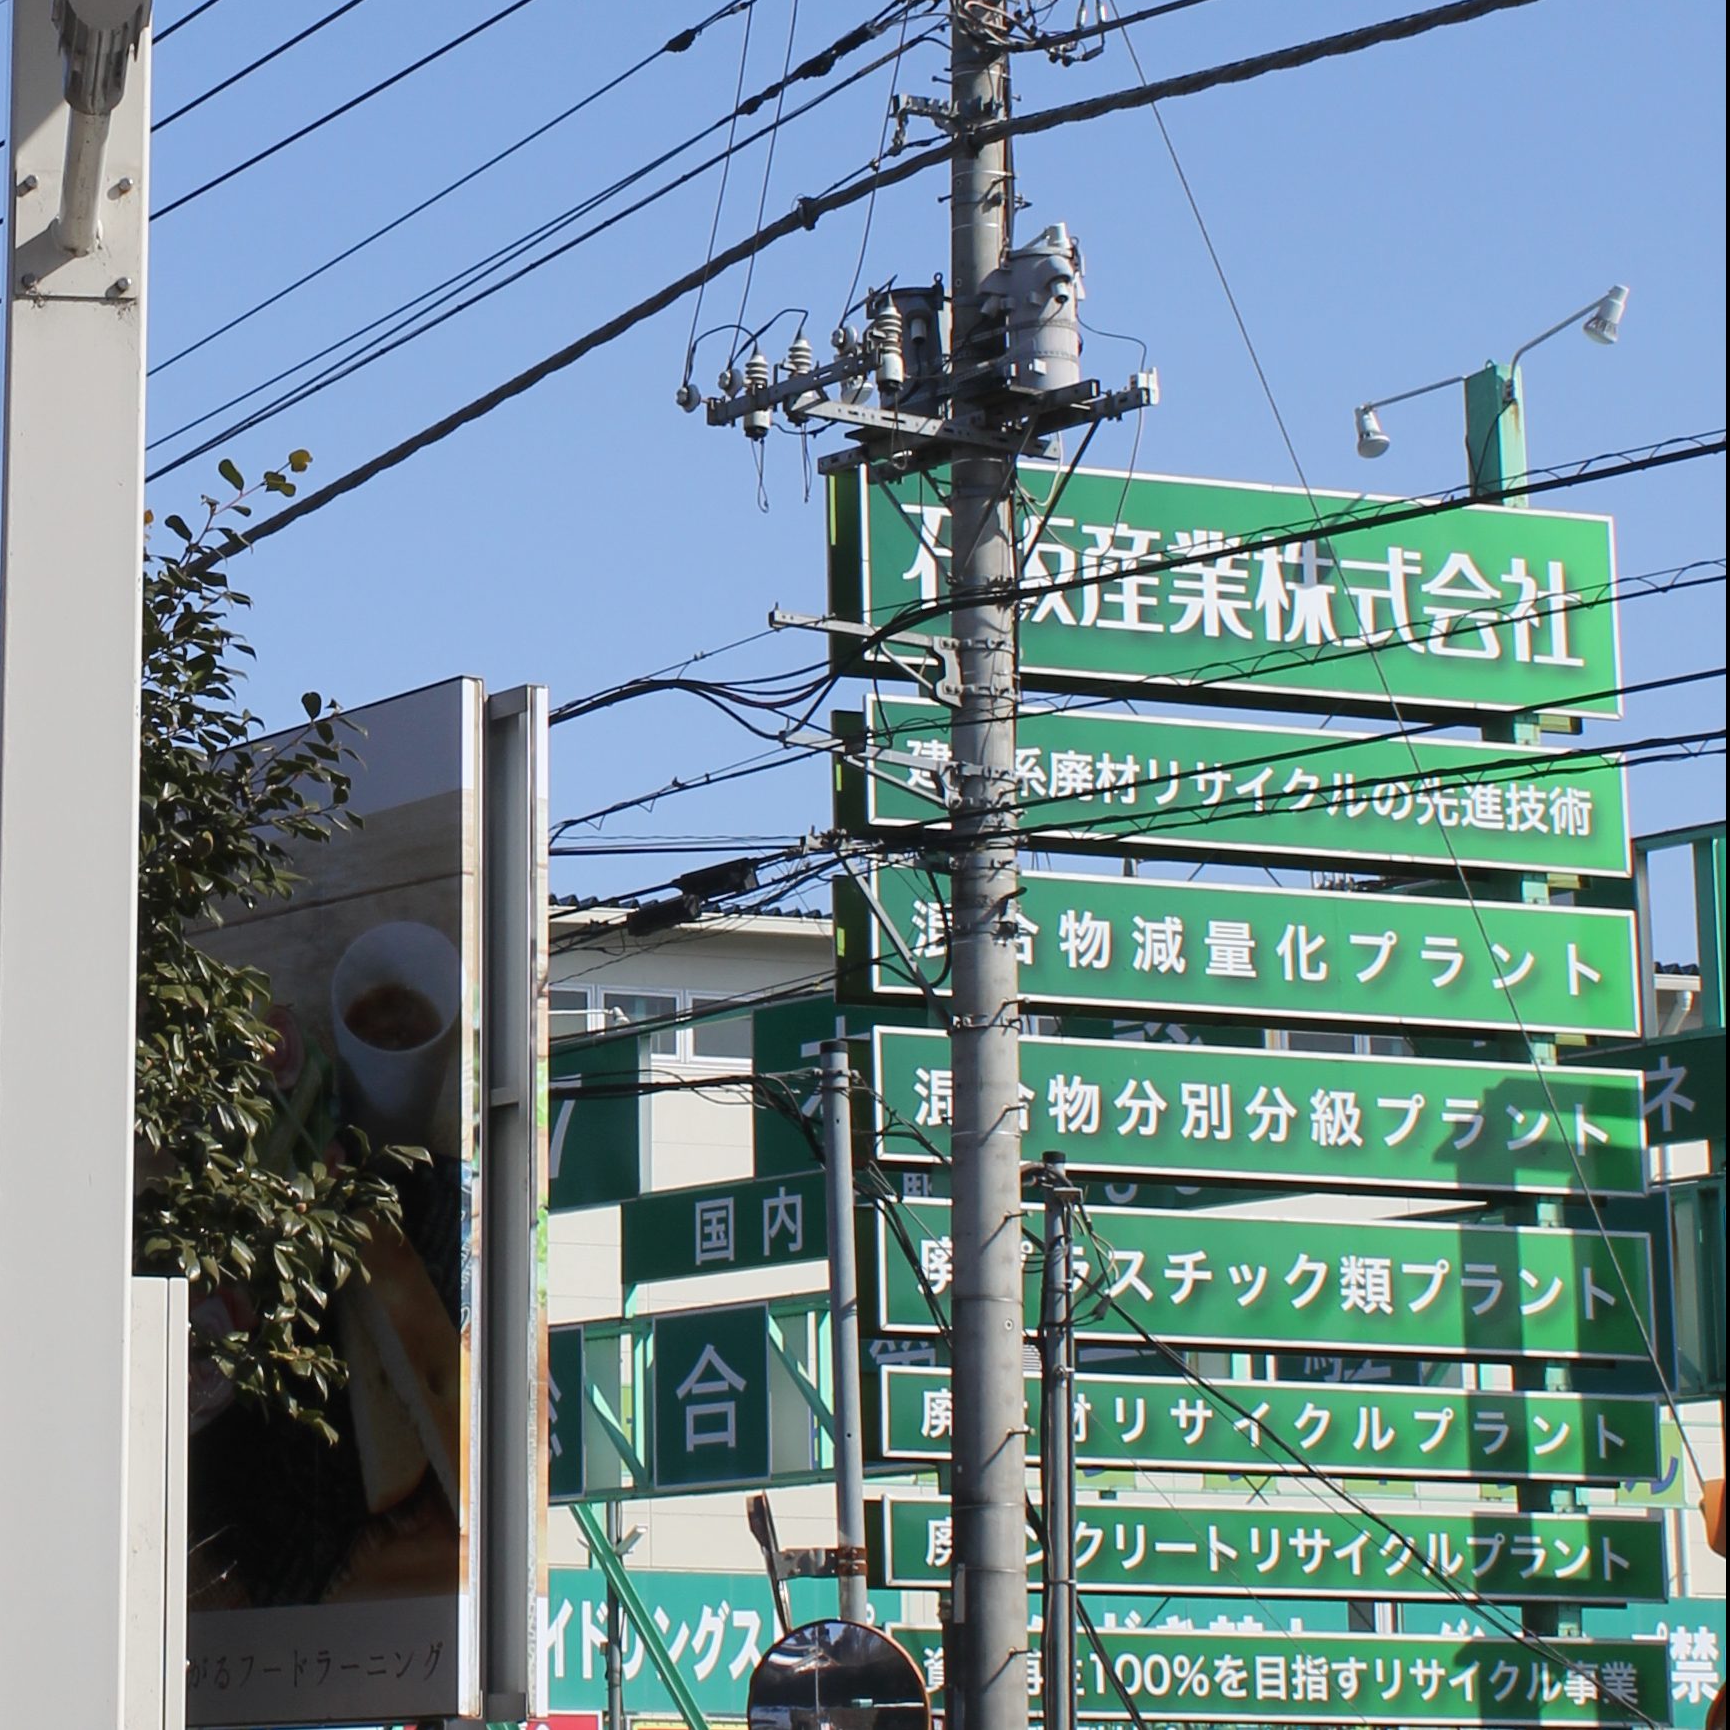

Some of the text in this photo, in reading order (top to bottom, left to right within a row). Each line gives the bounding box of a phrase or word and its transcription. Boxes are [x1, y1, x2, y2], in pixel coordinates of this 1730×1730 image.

[906, 738, 1592, 837] 建系廃材リサイクルの先進技術
[913, 1067, 1611, 1151] 混物分別分級プラント
[694, 1186, 803, 1265] 国内
[917, 1236, 1619, 1326] 廃スチック類プラント
[921, 1387, 1625, 1460] 廃リサイクルプラント
[925, 1516, 1630, 1582] 廃クリートリサイクルプラント
